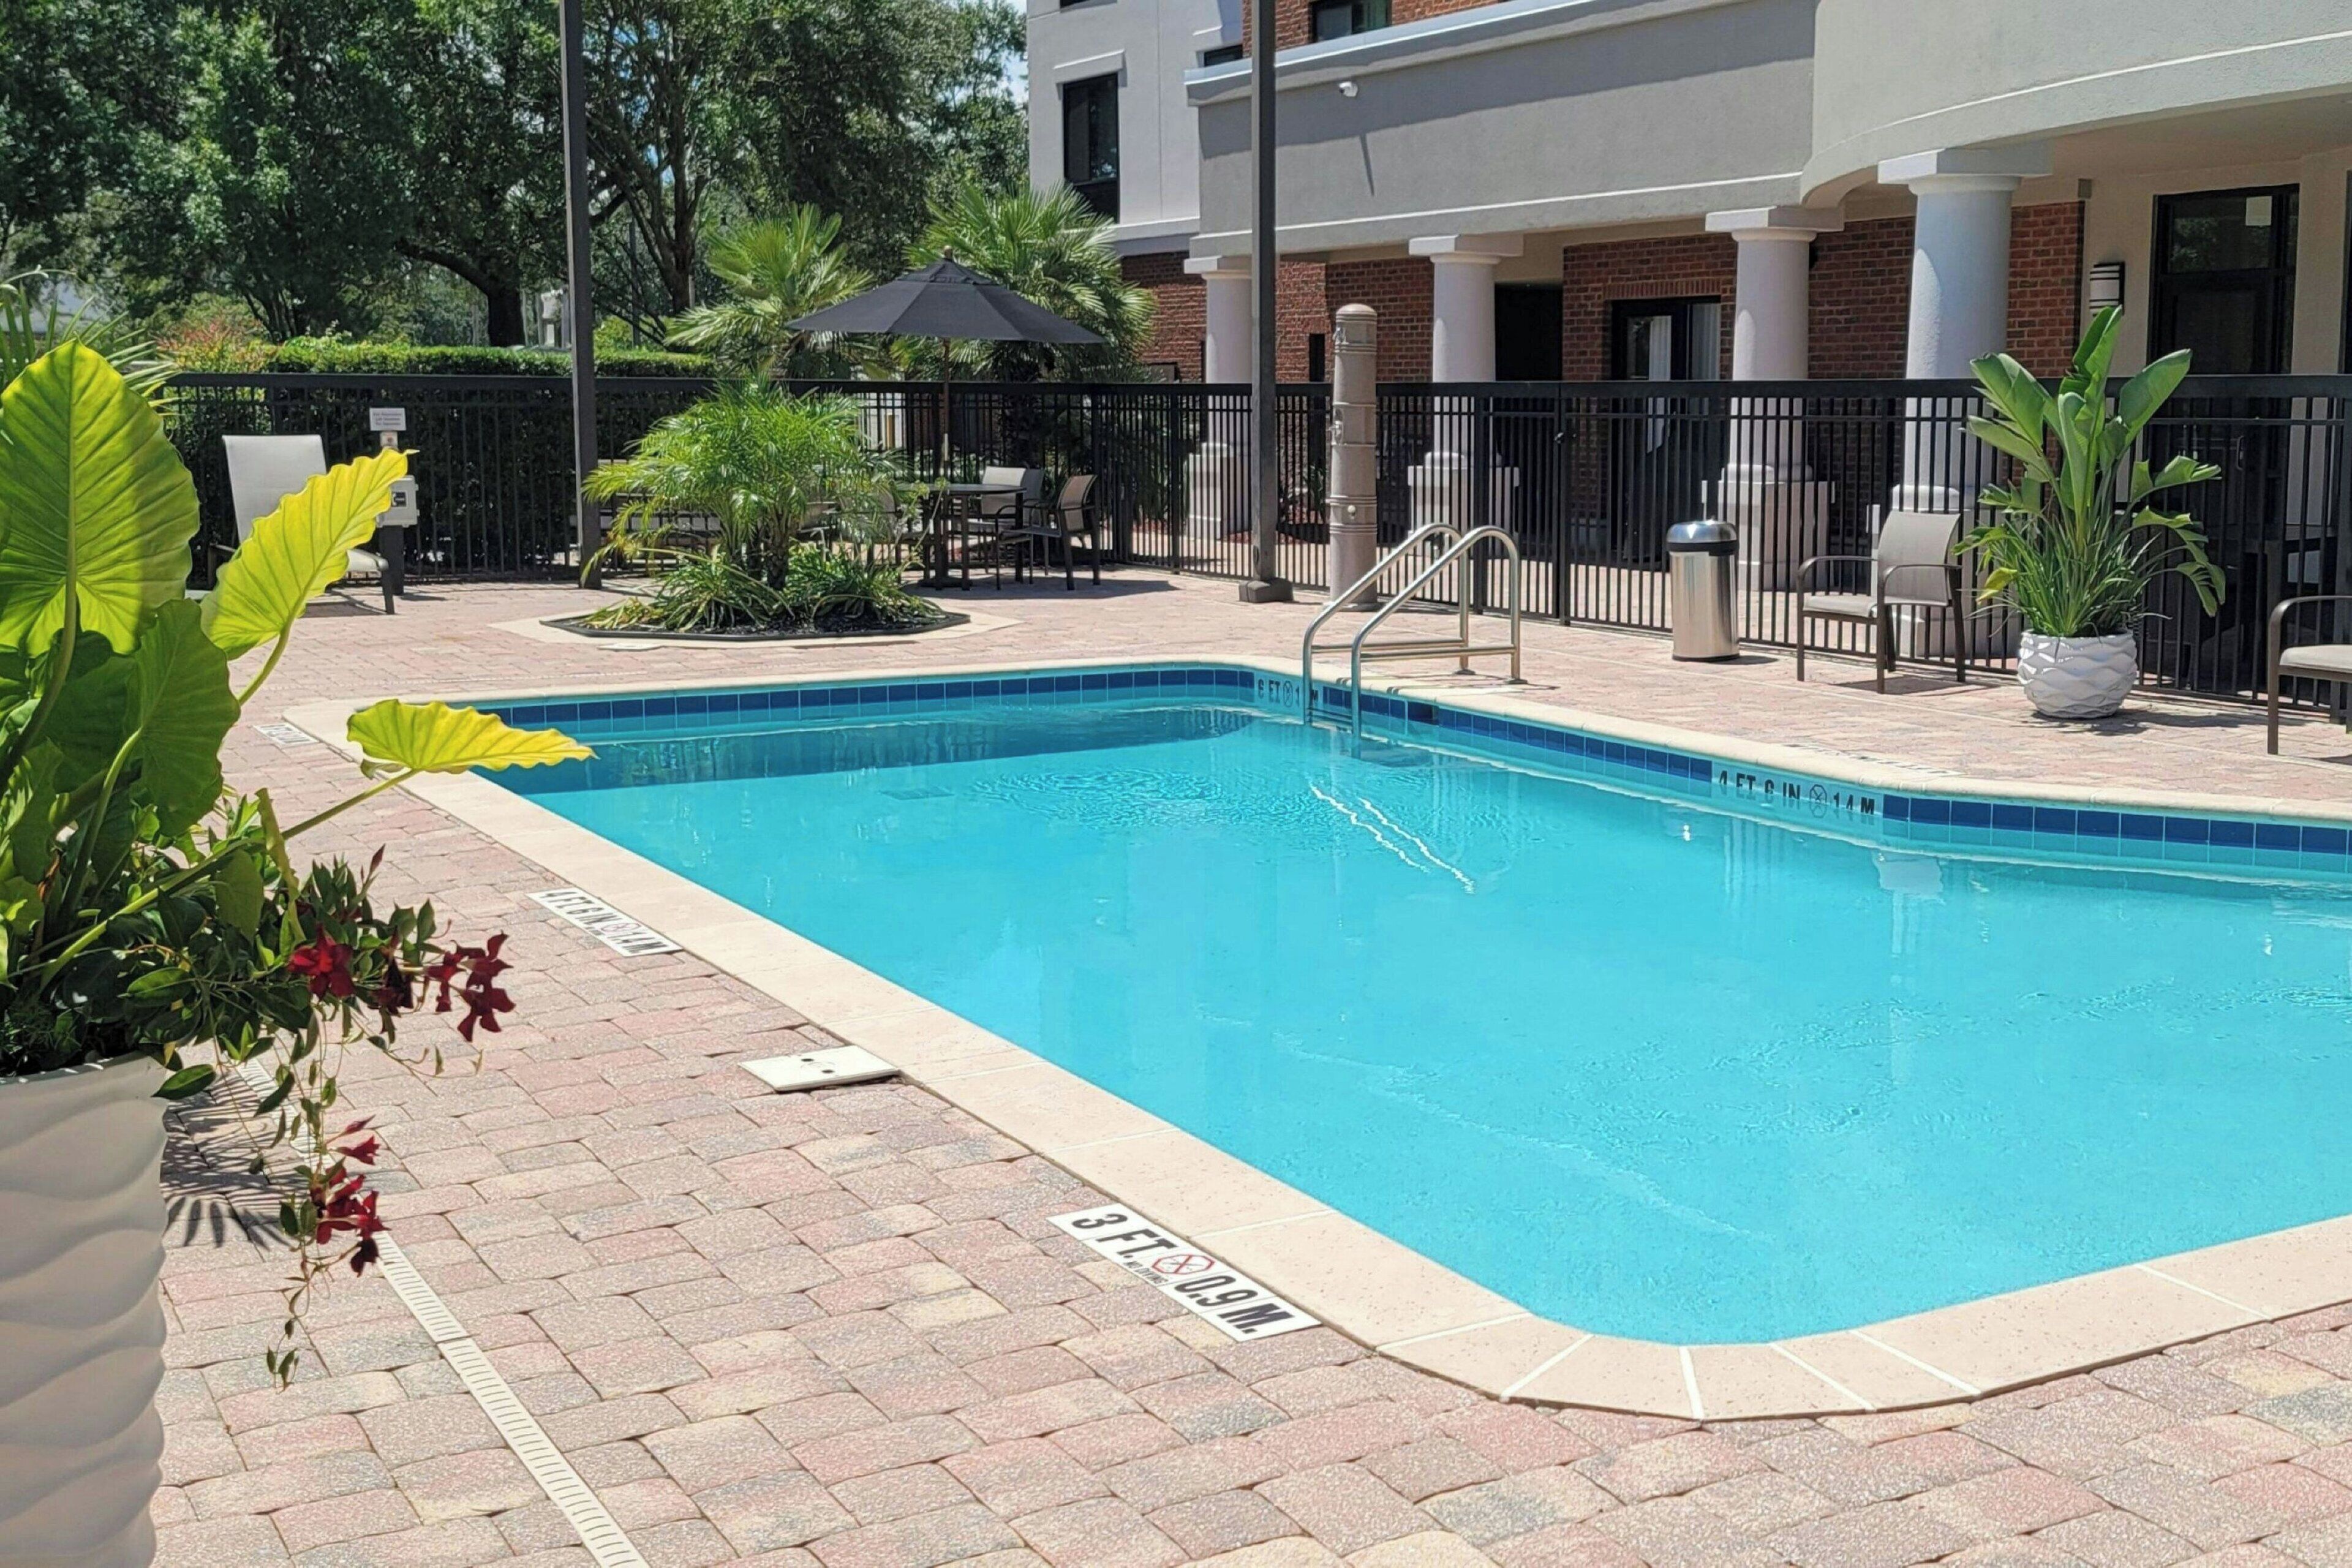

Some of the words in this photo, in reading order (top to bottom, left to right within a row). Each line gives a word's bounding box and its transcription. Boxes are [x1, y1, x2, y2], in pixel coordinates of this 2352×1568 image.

[1736, 772, 1756, 791] FT
[1783, 782, 1800, 800] IN
[1860, 796, 1875, 815] M
[1072, 1213, 1128, 1229] 3
[1095, 1228, 1178, 1259] FT.
[1174, 1275, 1258, 1307] 0.9
[1216, 1303, 1295, 1334] M.
